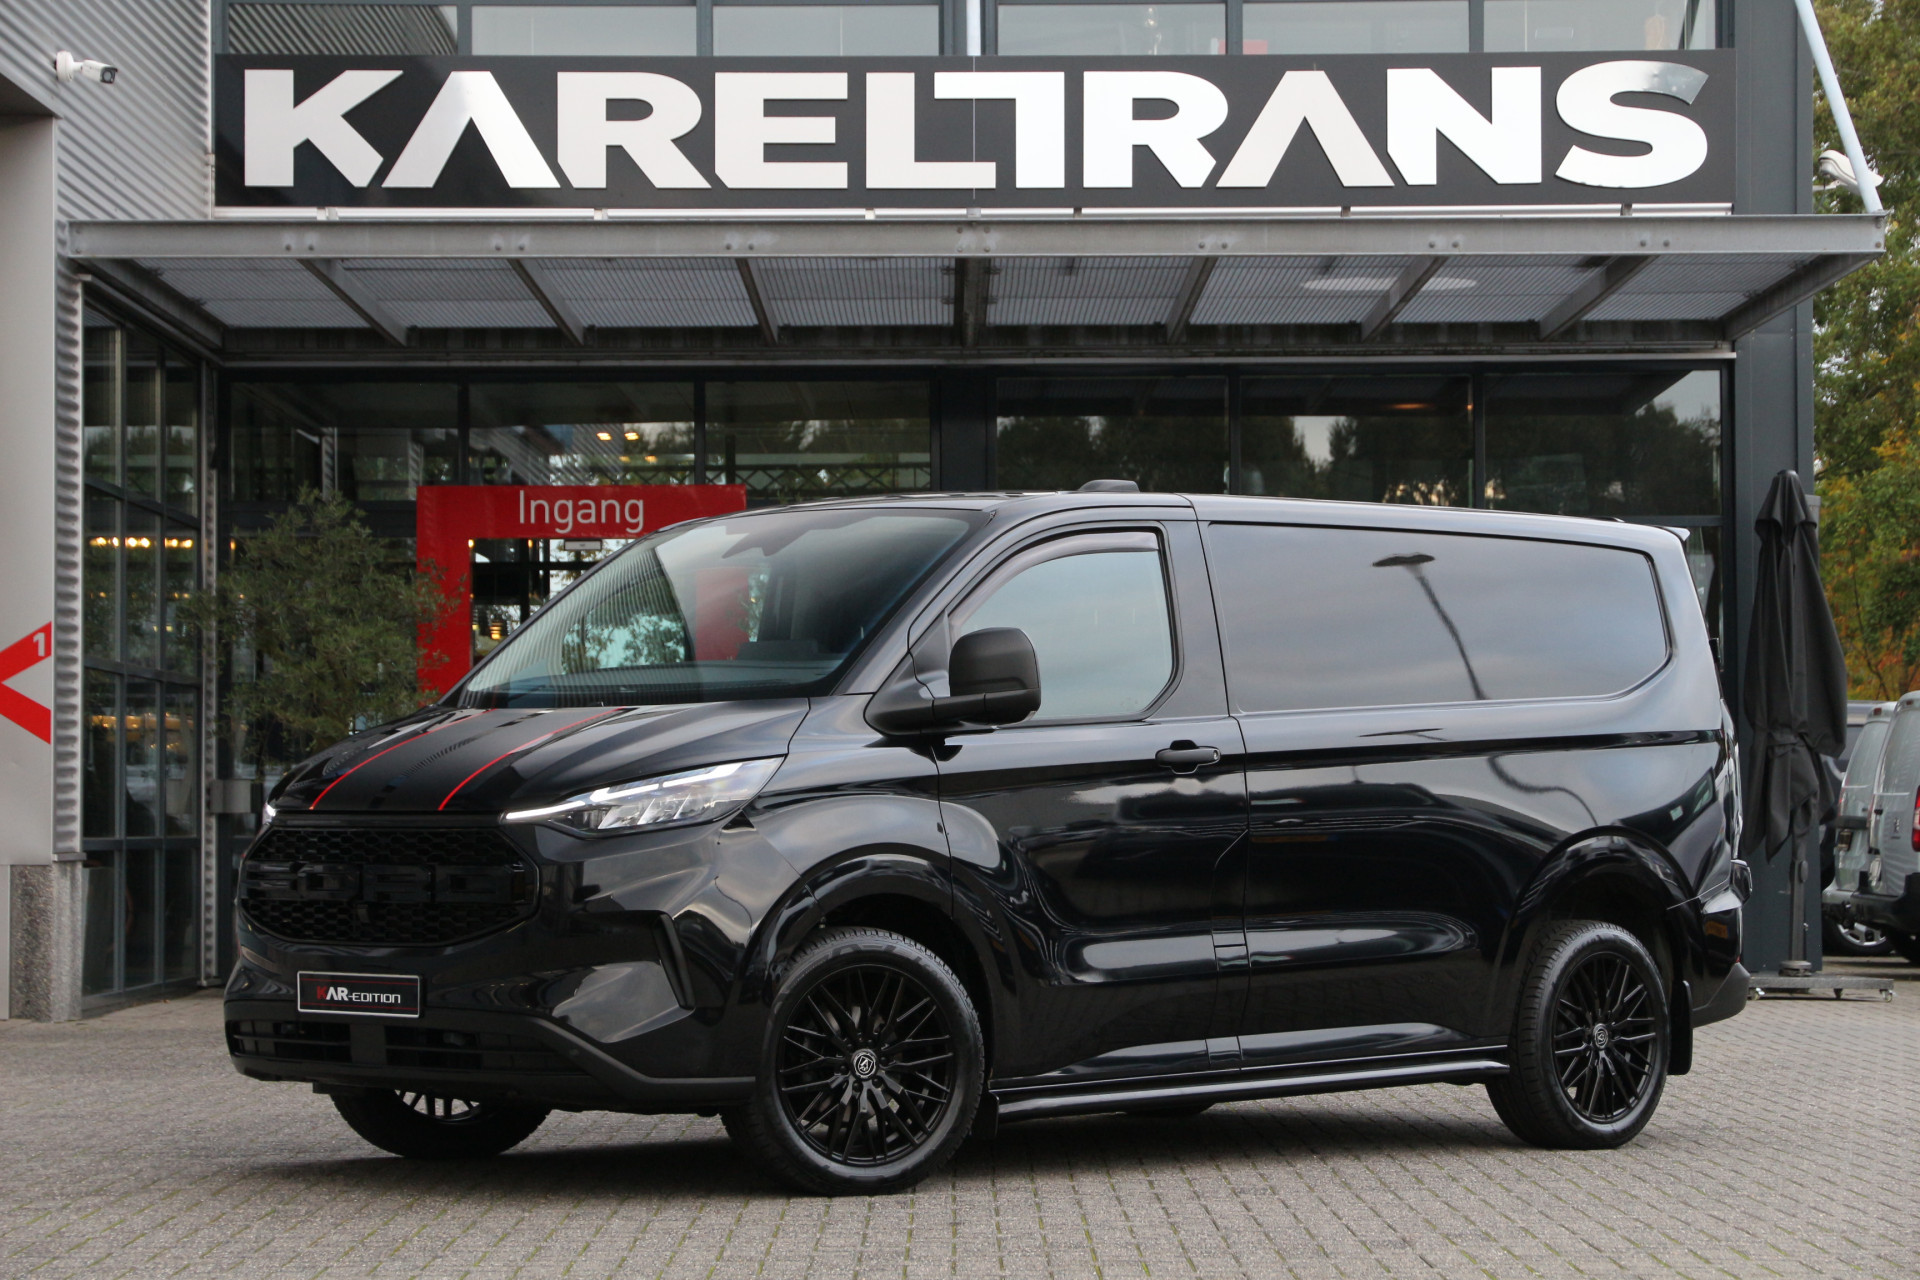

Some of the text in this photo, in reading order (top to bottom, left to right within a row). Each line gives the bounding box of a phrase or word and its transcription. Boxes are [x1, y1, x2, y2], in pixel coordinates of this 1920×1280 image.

[519, 489, 644, 534] Ingang
[33, 632, 46, 657] 1
[316, 985, 401, 1004] KAR-EDITION
